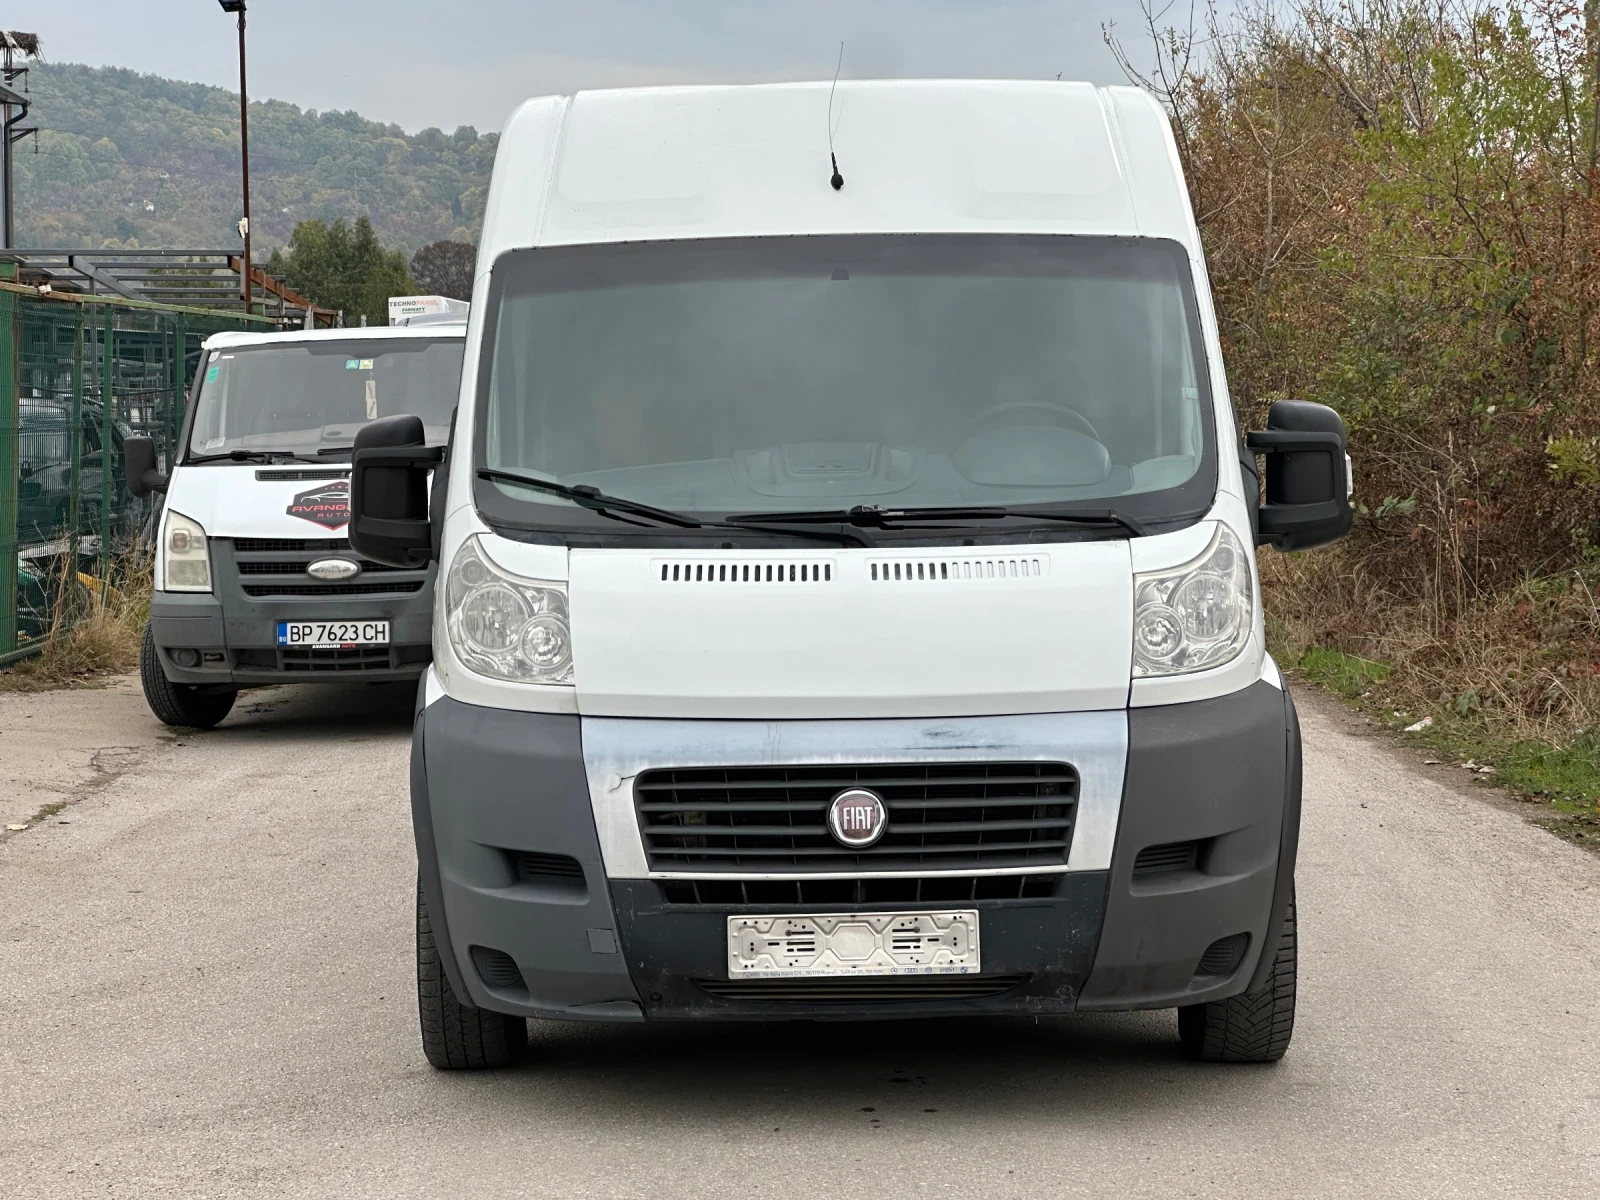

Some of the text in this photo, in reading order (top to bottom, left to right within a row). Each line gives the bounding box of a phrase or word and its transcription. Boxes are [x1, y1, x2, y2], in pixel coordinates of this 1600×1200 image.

[292, 504, 350, 512] AVANG
[290, 624, 386, 642] BP 7623 CH
[843, 806, 873, 830] FIAT
